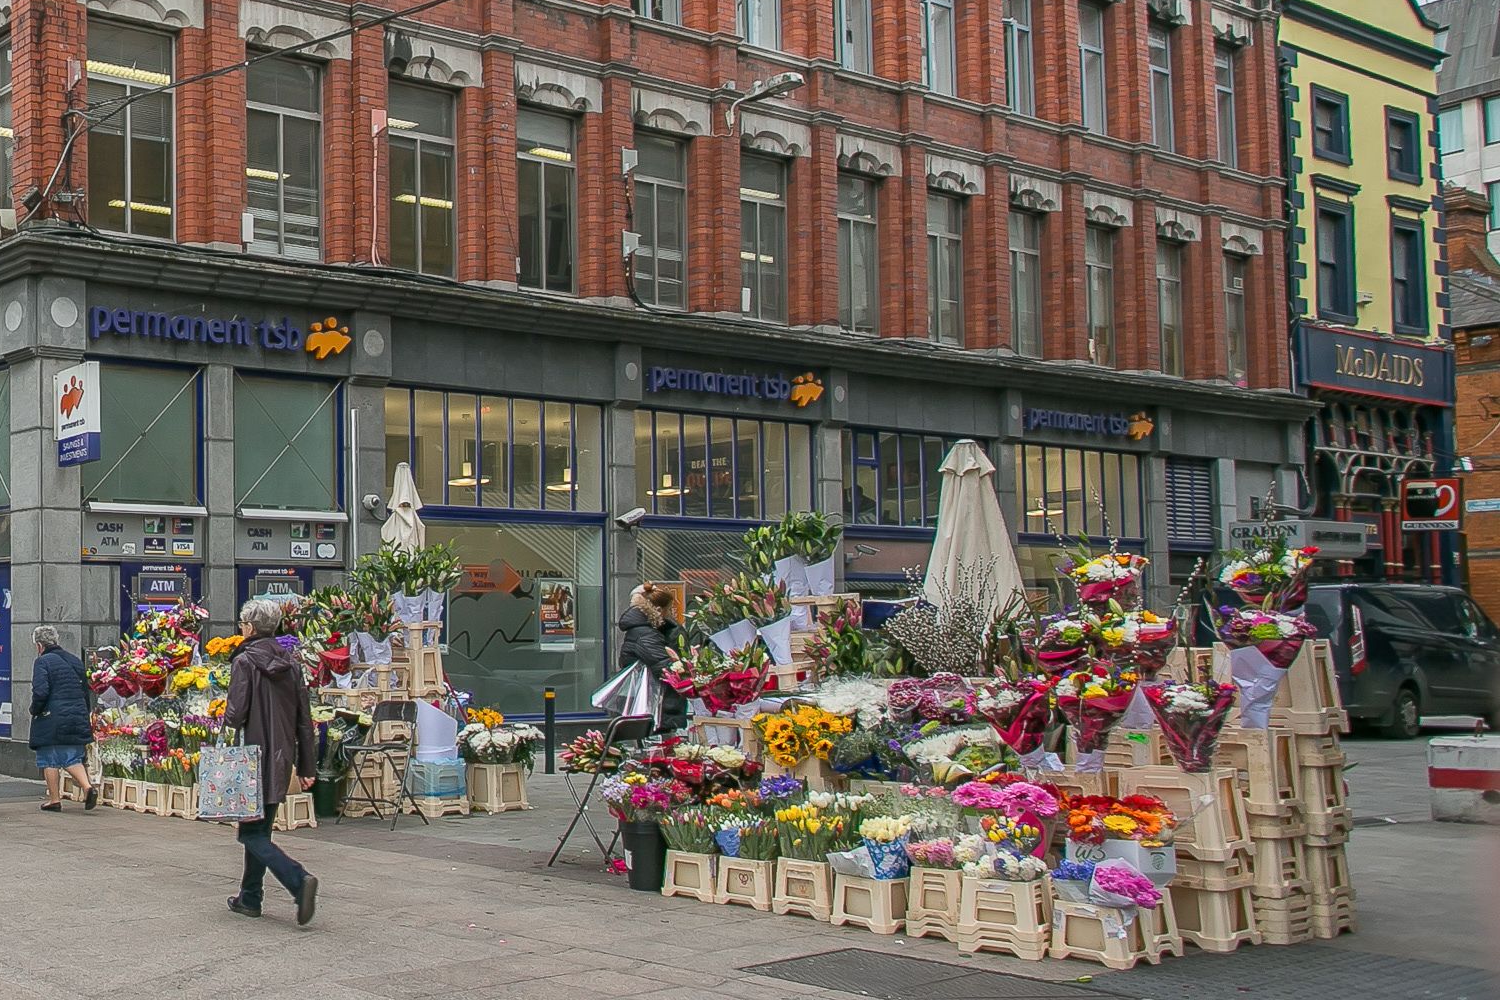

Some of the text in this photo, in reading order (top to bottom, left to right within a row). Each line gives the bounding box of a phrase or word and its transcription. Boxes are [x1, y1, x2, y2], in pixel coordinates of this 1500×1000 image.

[90, 304, 305, 351] permanent tsb
[1335, 344, 1424, 387] McDAIDS
[650, 366, 791, 399] permanent tsb
[1029, 408, 1129, 436] permanent tsb
[691, 457, 727, 469] BEA THE
[96, 522, 124, 533] CASH
[247, 528, 272, 537] CASH
[100, 537, 119, 546] ATM
[252, 542, 268, 551] ATM
[150, 580, 175, 592] ATM
[267, 583, 289, 594] ATM
